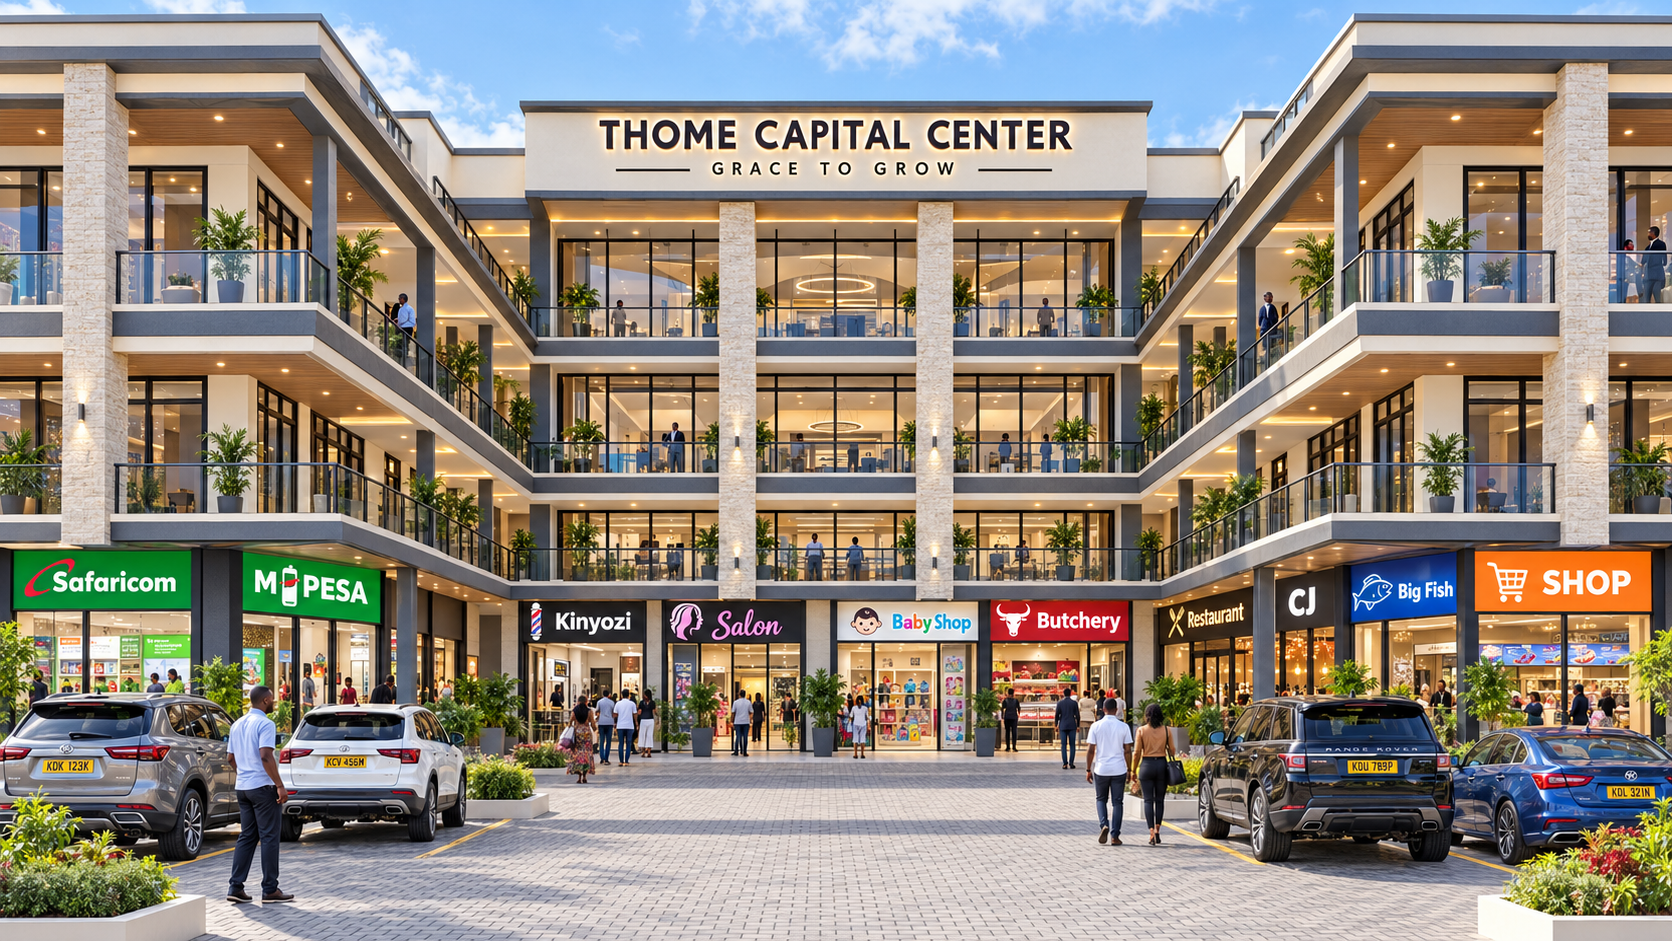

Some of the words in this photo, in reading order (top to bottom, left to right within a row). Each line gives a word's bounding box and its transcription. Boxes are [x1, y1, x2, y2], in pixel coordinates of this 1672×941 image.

[599, 119, 737, 151] THOME
[755, 118, 911, 151] CAPITAL
[927, 118, 1073, 151] CENTER
[712, 161, 798, 176] GRACE
[819, 161, 852, 176] TO
[874, 161, 954, 176] GROW
[52, 570, 177, 593] Safaricom
[1398, 582, 1421, 603] Big
[1425, 580, 1454, 599] Fish
[1542, 569, 1632, 596] SHOP
[1288, 586, 1316, 617] CJ
[555, 611, 632, 636] Kinyozi
[711, 608, 783, 641] Salon
[892, 613, 932, 634] Baby
[934, 613, 972, 634] Shop
[1037, 611, 1121, 633] Butchery
[1187, 603, 1245, 629] Restaurant
[68, 761, 90, 772] 123K
